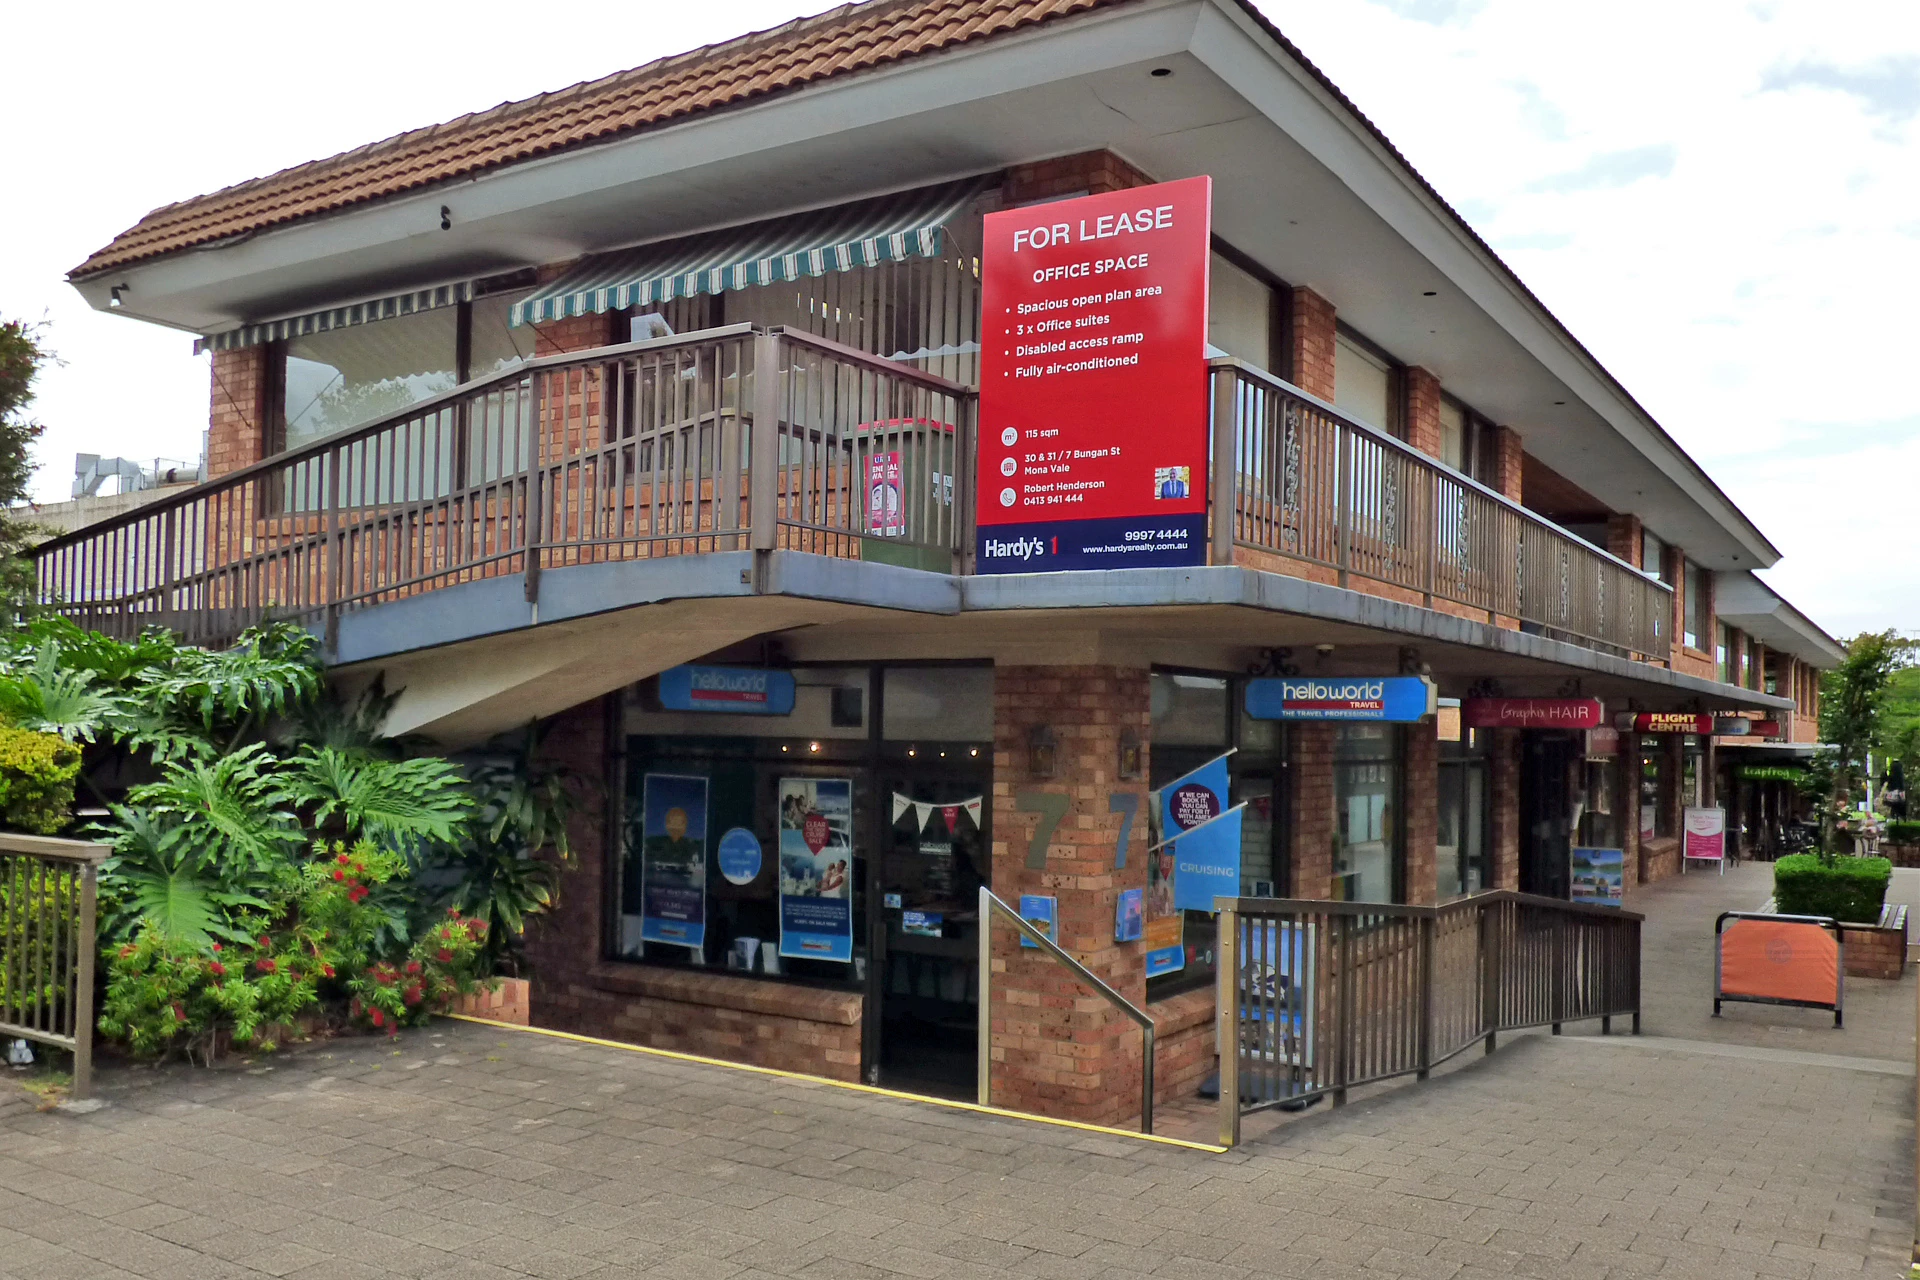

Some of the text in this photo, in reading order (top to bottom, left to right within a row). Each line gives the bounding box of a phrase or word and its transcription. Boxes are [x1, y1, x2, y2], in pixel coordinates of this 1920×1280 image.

[1013, 205, 1174, 252] FOR LEASE
[1033, 253, 1149, 283] OFFICE SPACE
[1017, 285, 1163, 316] Spacious open plan area
[1016, 314, 1111, 336] 3 x Office suites
[1016, 332, 1144, 357] Disabled access ramp
[1015, 353, 1139, 379] Fully air-conditioned
[1025, 427, 1059, 439] 115 sqm
[1024, 446, 1121, 463] 30 & 31 / 7 Bungan St
[1024, 463, 1070, 476] Mona Vale
[1024, 479, 1106, 494] Robert Henderson
[1023, 493, 1084, 506] 0413 941 444
[1125, 528, 1189, 541] 9997 4444
[985, 536, 1059, 562] Hardy's 1
[1082, 542, 1189, 555] www.hardysrealty.com.au
[742, 693, 763, 701] TRAVEL
[1282, 681, 1384, 700] helloworld
[1349, 701, 1380, 709] TRAVEL
[1501, 701, 1589, 727] Graphix HAIR
[1651, 713, 1697, 723] FLIGHT
[1648, 723, 1698, 733] CENTRE
[1016, 791, 1071, 870] 7
[1109, 792, 1139, 870] 7
[1179, 862, 1235, 878] CRUISING
